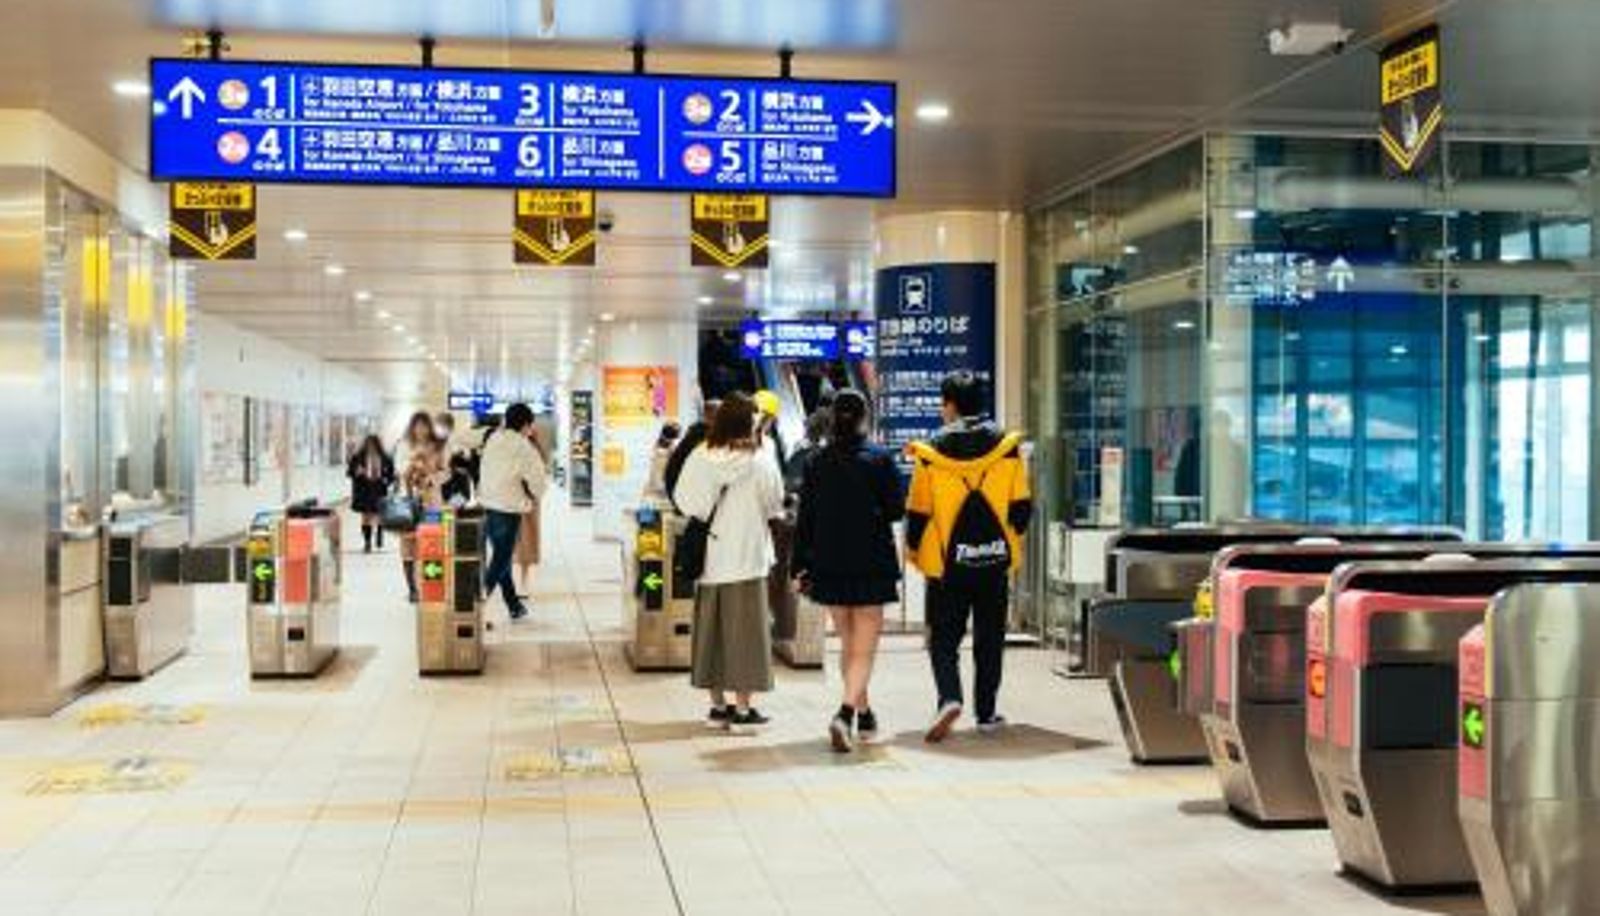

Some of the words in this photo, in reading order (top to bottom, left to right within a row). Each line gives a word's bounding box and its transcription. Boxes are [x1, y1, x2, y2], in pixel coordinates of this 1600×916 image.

[259, 75, 277, 109] 1
[519, 83, 541, 117] 3
[719, 89, 741, 121] 2
[256, 127, 282, 161] 4
[519, 134, 541, 169] 6
[720, 140, 741, 172] 5
